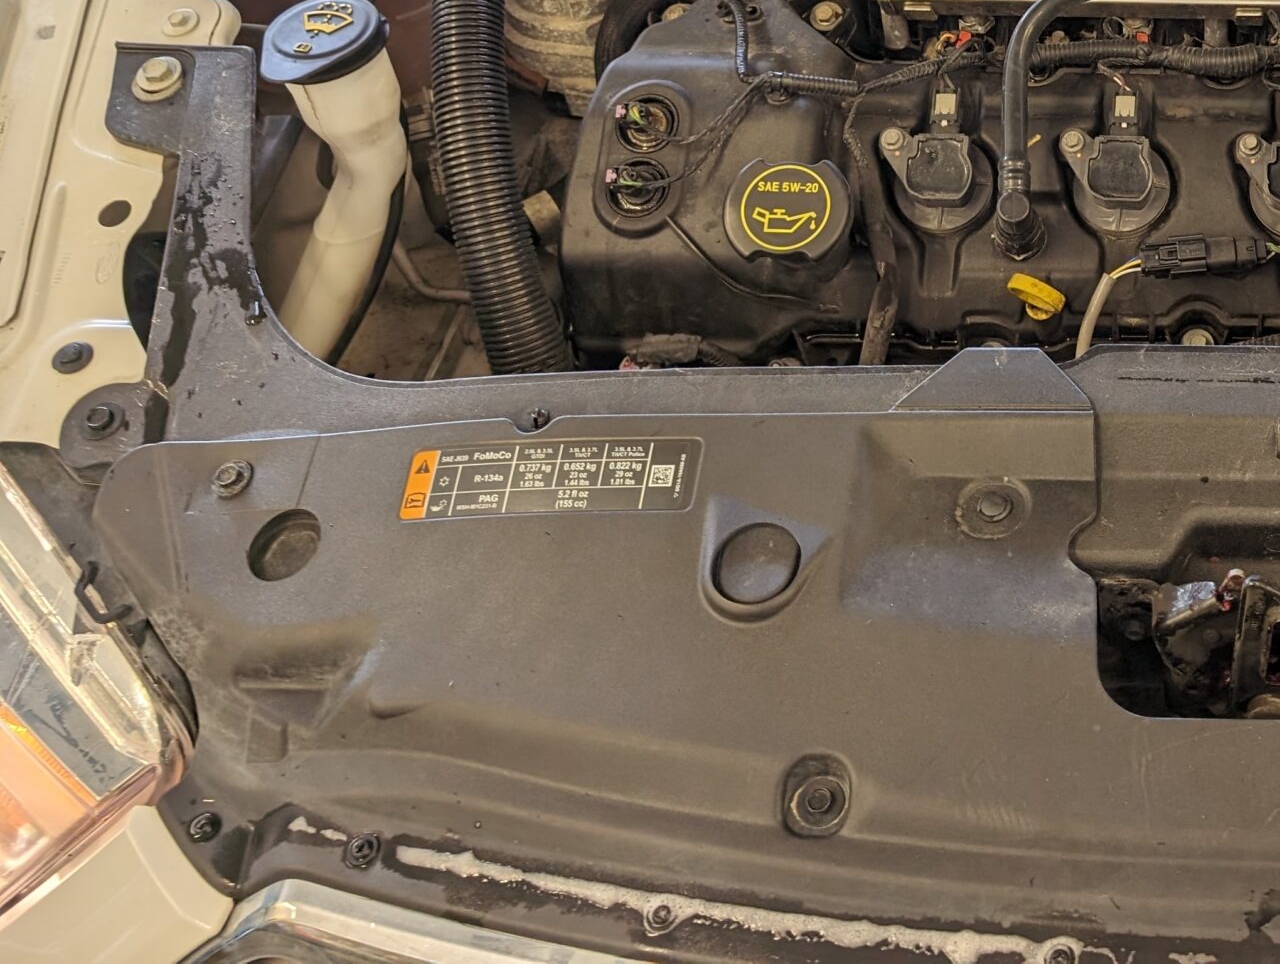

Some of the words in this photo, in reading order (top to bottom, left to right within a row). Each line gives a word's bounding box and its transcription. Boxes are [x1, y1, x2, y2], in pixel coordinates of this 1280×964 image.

[757, 181, 779, 192] SAE
[782, 182, 819, 193] 5W-20
[473, 451, 512, 460] FoMoCo
[519, 464, 540, 472] 0.737
[541, 464, 552, 473] kg
[563, 463, 585, 471] 0.652
[586, 462, 597, 472] kg
[609, 462, 631, 470] 0.822
[632, 462, 642, 471] kg
[474, 474, 504, 482] R-134a
[557, 490, 570, 498] 5.2
[571, 489, 577, 497] fl
[478, 494, 499, 503] PAG
[555, 499, 572, 510] (155
[573, 499, 587, 509] cc)
